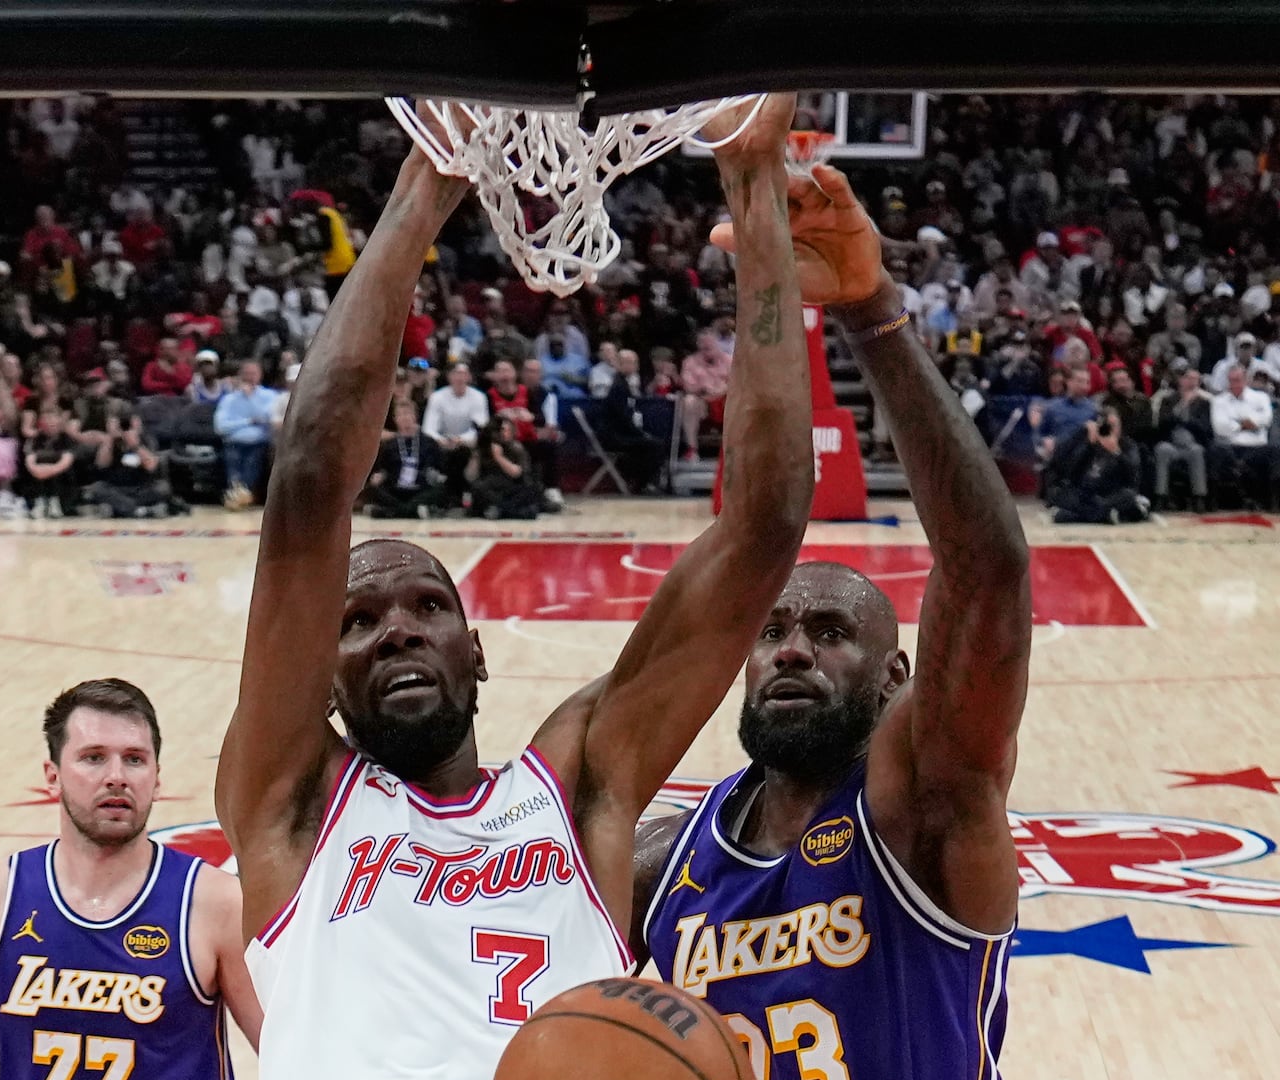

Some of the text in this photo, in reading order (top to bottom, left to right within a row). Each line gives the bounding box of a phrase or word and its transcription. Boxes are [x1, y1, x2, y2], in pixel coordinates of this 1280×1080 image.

[329, 832, 576, 923] H-Town
[807, 828, 852, 850] bibigo
[128, 934, 166, 950] bibigo
[471, 926, 550, 1027] 7
[672, 895, 871, 999] LAKERS
[0, 955, 167, 1024] LAKERS
